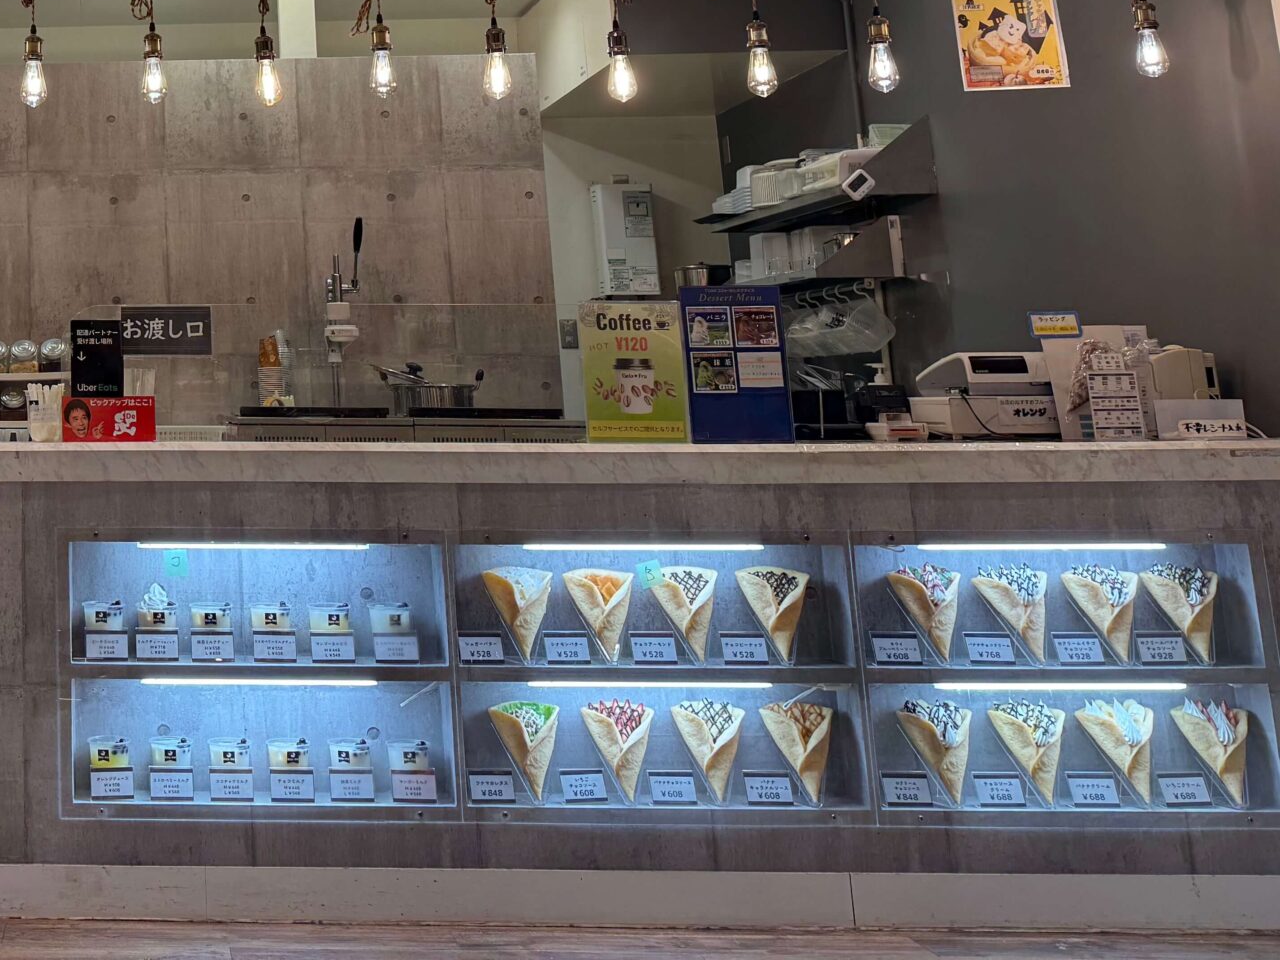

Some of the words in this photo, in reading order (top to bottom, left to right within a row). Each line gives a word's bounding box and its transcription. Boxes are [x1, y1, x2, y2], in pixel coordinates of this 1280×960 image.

[596, 313, 651, 331] Coffee
[123, 319, 203, 339] お渡し口
[615, 337, 648, 351] ¥120
[470, 650, 491, 658] ¥528
[557, 650, 578, 658] ¥528
[733, 651, 755, 659] ¥528
[978, 651, 1000, 659] ¥768
[1150, 652, 1173, 660] ¥928
[481, 789, 503, 797] ¥848
[573, 789, 594, 797] ¥608
[661, 790, 683, 798] ¥608
[896, 793, 918, 801] ¥848
[1082, 793, 1105, 801] ¥688
